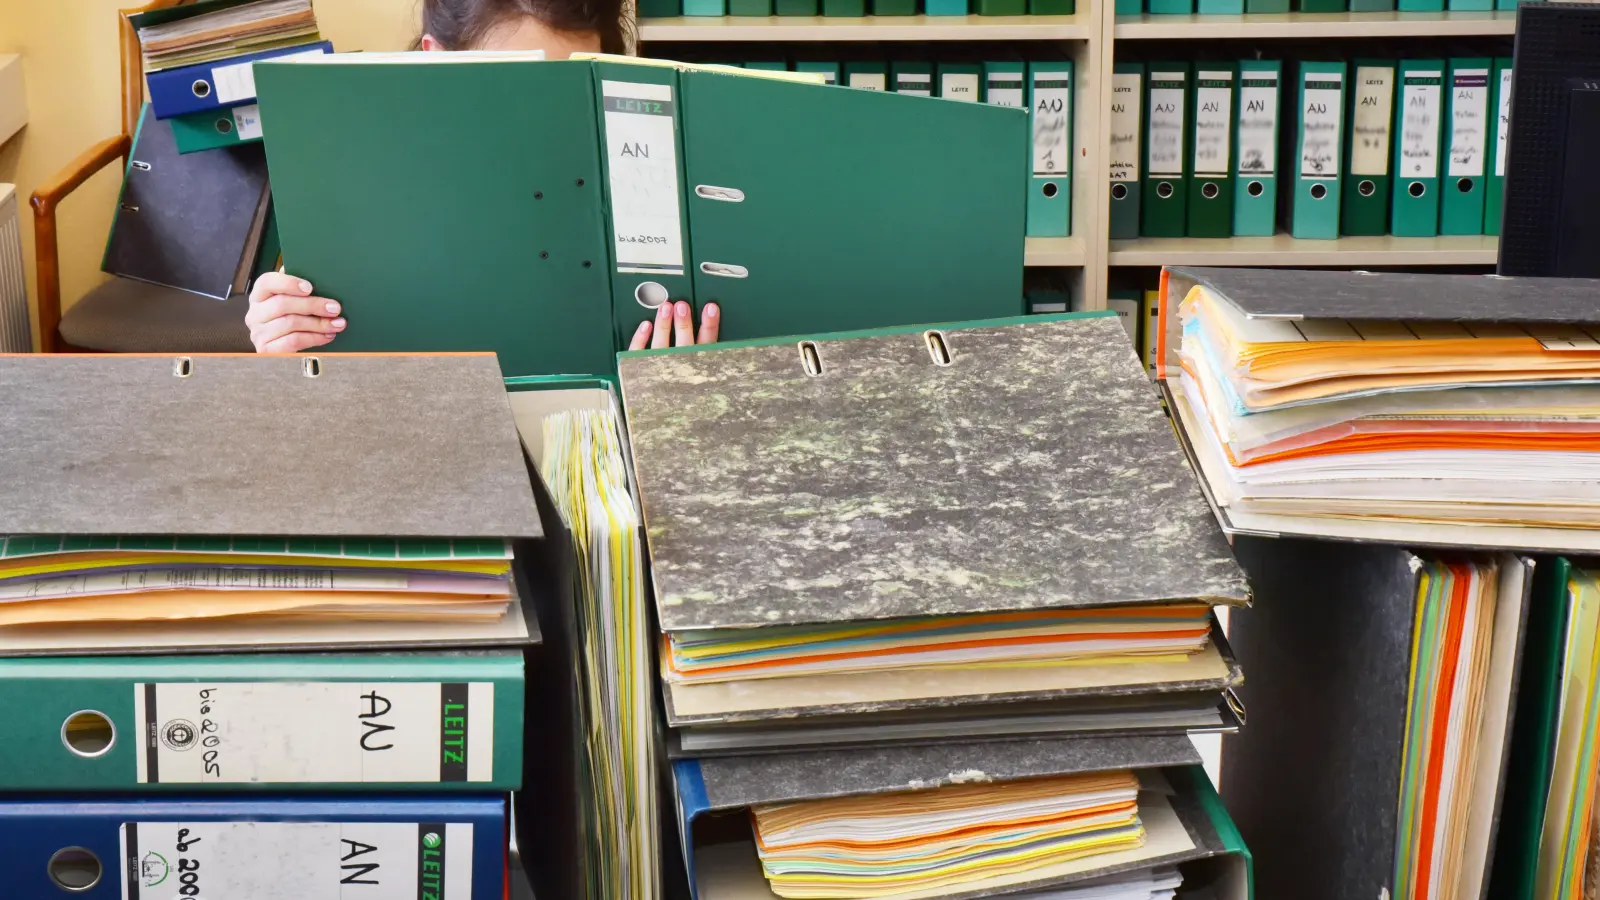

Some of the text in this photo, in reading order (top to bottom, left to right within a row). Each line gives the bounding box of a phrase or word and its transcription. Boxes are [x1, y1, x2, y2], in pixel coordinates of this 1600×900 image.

[1361, 96, 1378, 106] AN
[1409, 95, 1426, 107] AN
[1458, 90, 1474, 100] AN
[616, 99, 663, 114] LEITZ
[1037, 98, 1063, 114] AN
[1154, 103, 1176, 113] AN
[1201, 101, 1219, 112] AN
[1246, 99, 1265, 112] AN
[1307, 103, 1327, 114] AN
[620, 142, 650, 159] AN
[358, 689, 396, 752] AN
[444, 703, 465, 764] LEITZ
[176, 828, 202, 900] ab 200
[340, 838, 380, 885] AN
[423, 849, 441, 900] LEITZ
